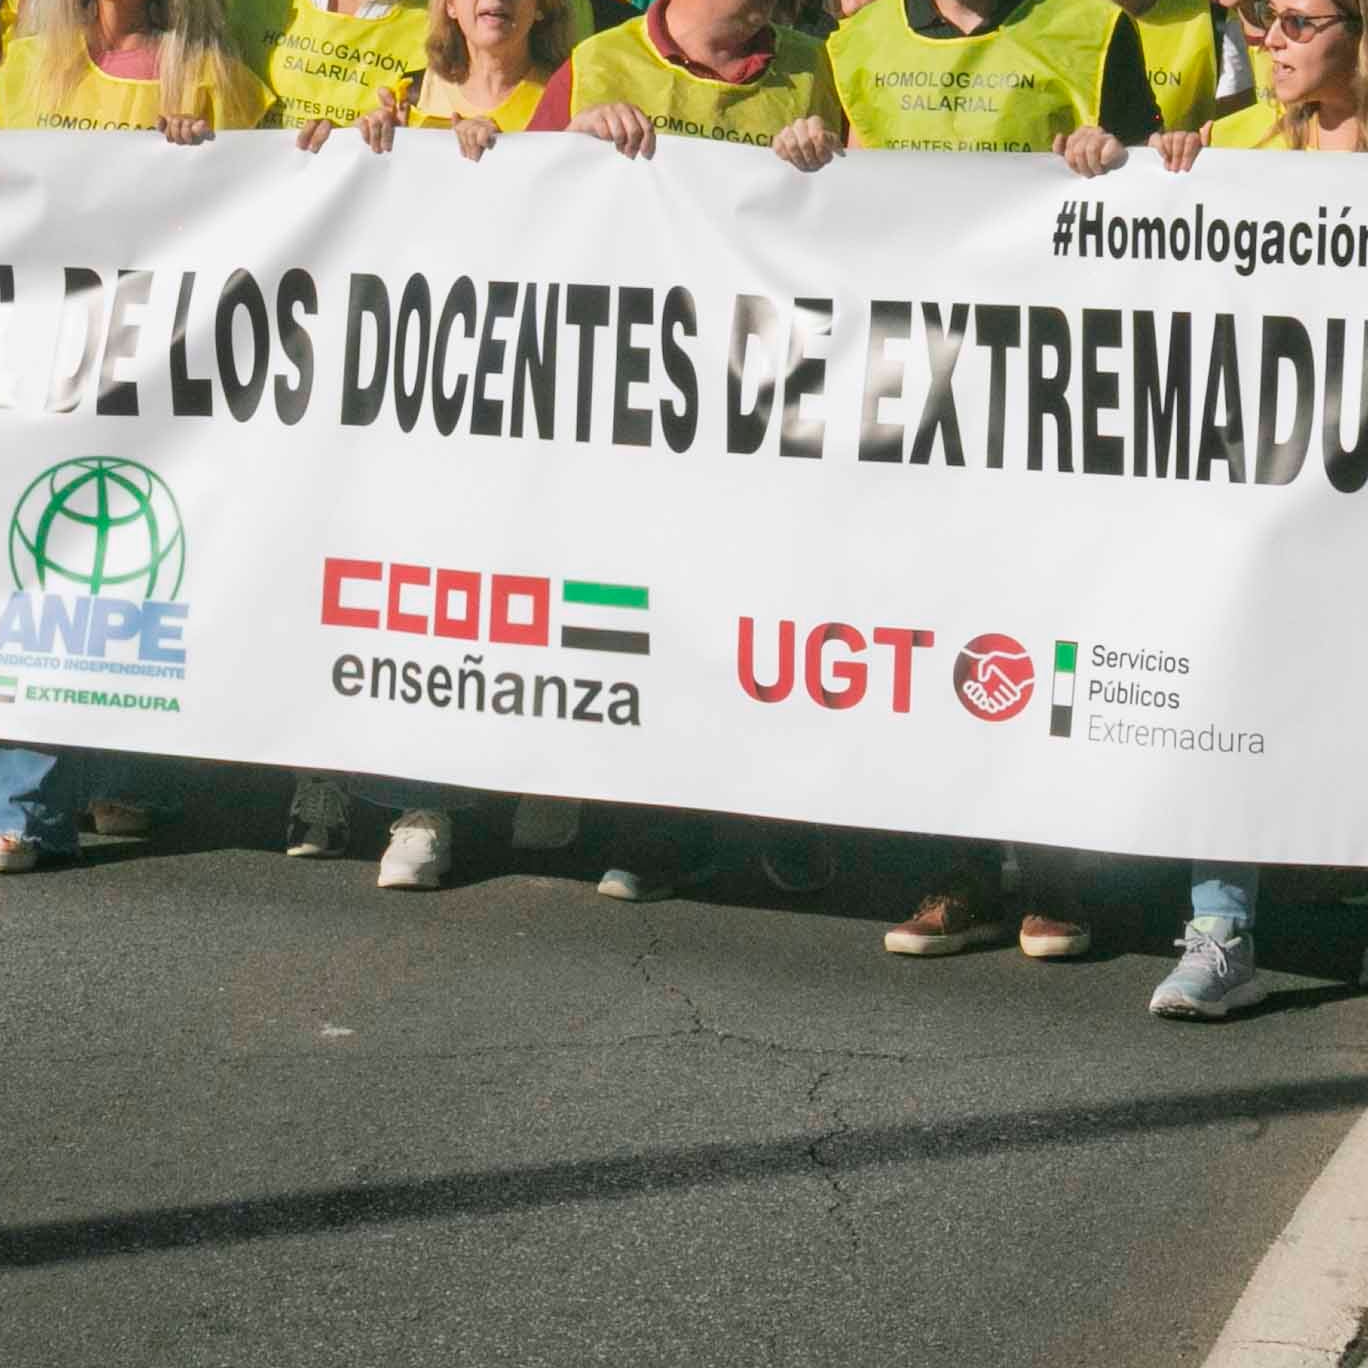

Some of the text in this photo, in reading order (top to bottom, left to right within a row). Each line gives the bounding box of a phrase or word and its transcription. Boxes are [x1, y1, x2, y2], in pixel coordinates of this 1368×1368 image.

[262, 30, 409, 75] HOMOLOGACIÓN
[283, 55, 370, 87] SALARIAL
[873, 70, 1035, 89] HOMOLOGACIÓN
[900, 95, 1000, 113] SALARIAL
[44, 266, 155, 417] DE
[170, 267, 320, 426] LOS
[340, 271, 700, 456] DOCENTES
[725, 292, 835, 460] DE
[320, 556, 551, 648] CCOO
[63, 660, 186, 681] INDEPENDIENTE
[737, 615, 935, 714] UGT
[1090, 643, 1190, 675] Servicios
[25, 684, 181, 714] EXTREMADURA
[331, 652, 642, 728] enseñanza
[1088, 679, 1181, 710] Públicos
[1087, 713, 1266, 755] Extremadura
